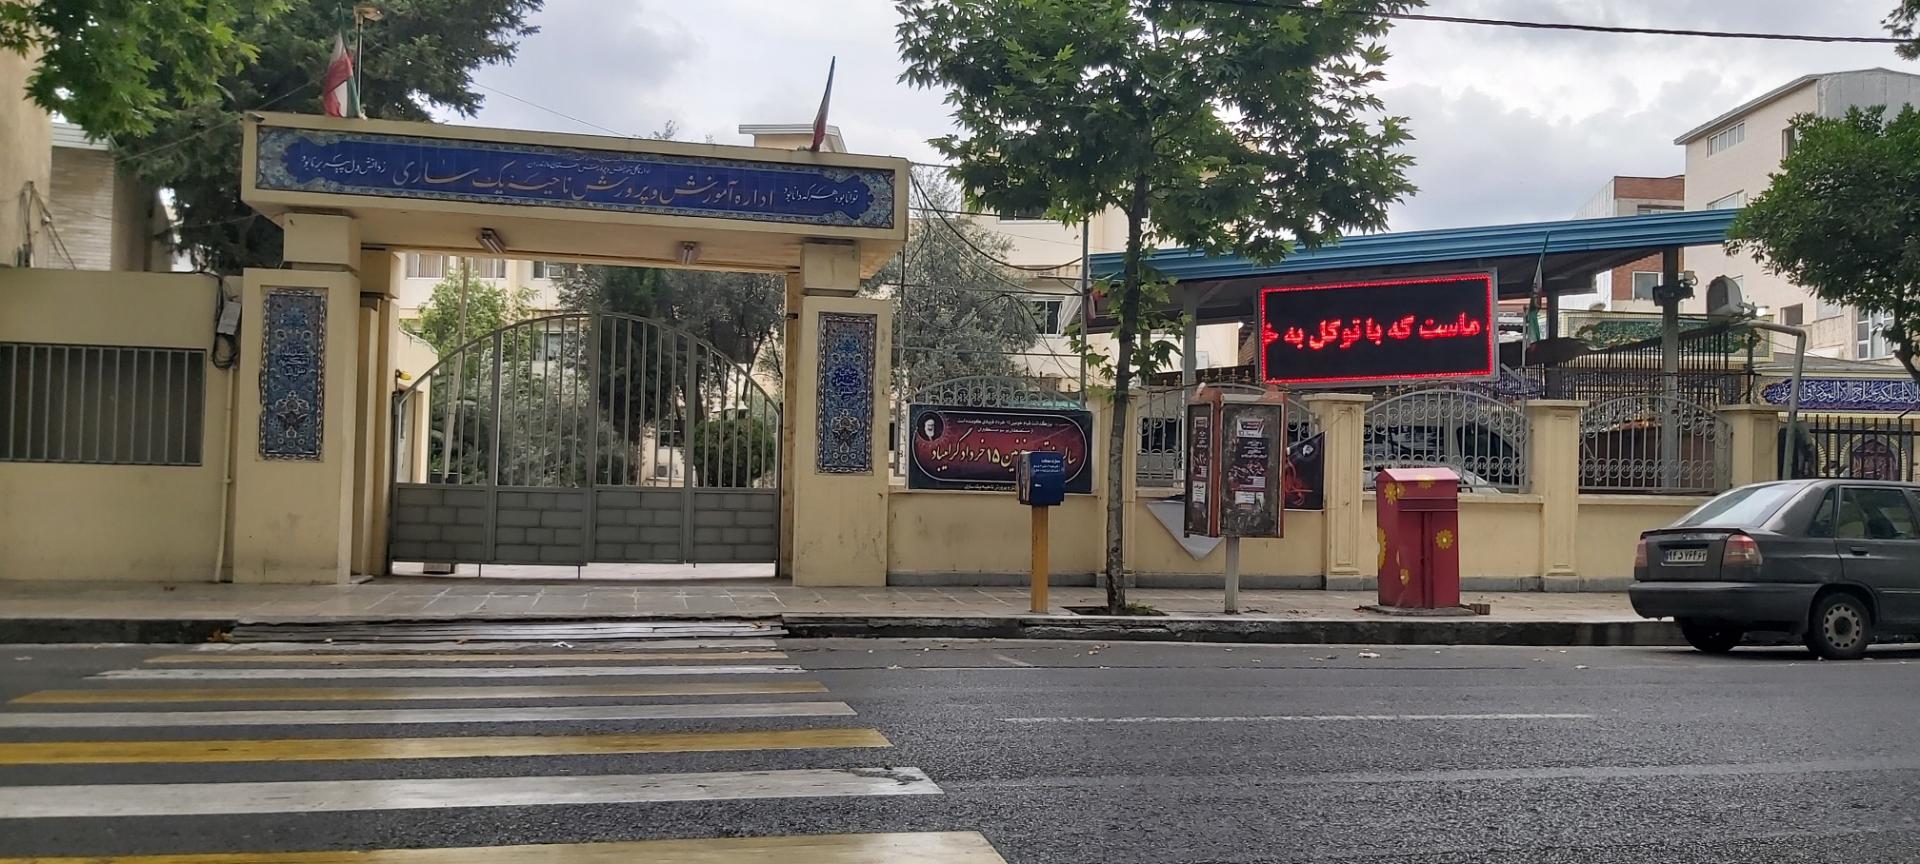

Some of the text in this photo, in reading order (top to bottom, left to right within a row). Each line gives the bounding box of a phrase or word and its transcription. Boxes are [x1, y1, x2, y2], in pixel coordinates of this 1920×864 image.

[301, 155, 310, 170] بود
[310, 156, 323, 172] برنا
[345, 159, 360, 174] دل
[360, 157, 380, 175] دانش
[392, 160, 775, 207] اداره آموزش و پرورش ناحیه یک ساری
[1284, 325, 1304, 350] به
[1309, 318, 1361, 350] توکل
[1366, 317, 1383, 346] با
[1387, 314, 1416, 339] که
[960, 438, 986, 461] خرداد
[987, 448, 1000, 463] ۱۵
